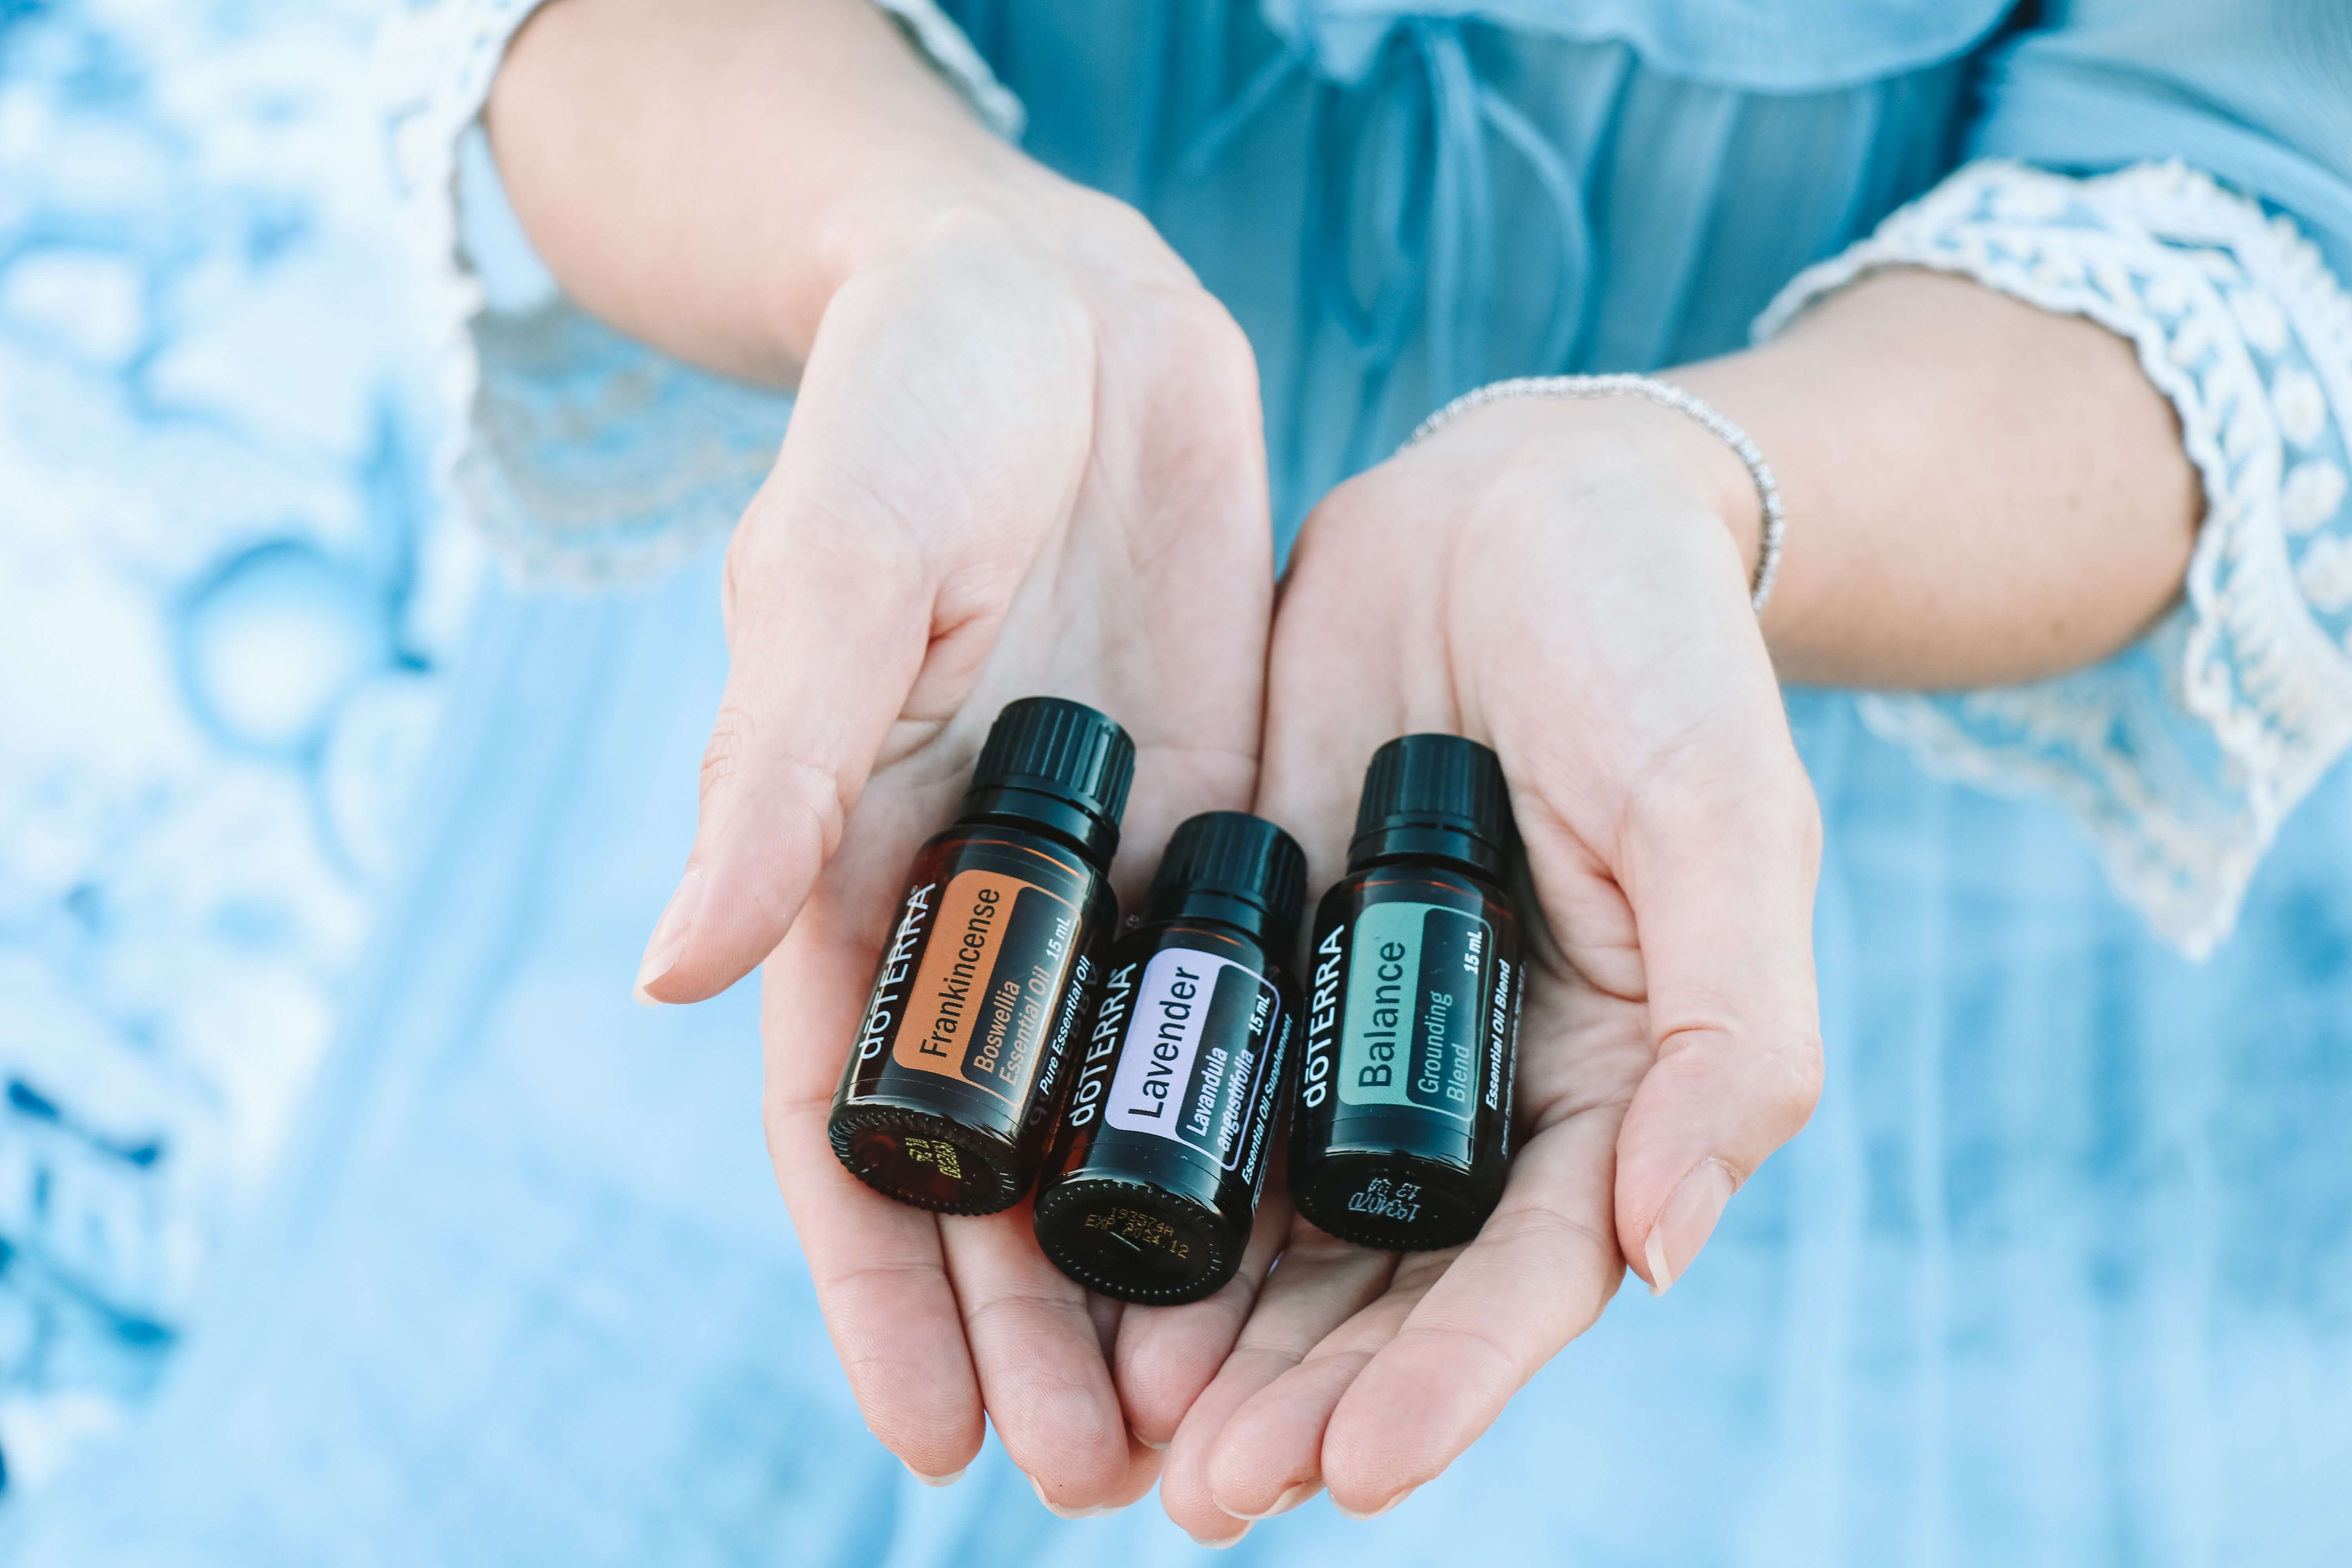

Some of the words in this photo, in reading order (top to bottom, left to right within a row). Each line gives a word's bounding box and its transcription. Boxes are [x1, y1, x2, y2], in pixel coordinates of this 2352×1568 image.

[920, 888, 1000, 1058] Frankincense
[1046, 938, 1062, 961] 15
[1056, 917, 1071, 940] mL
[1463, 953, 1479, 975] 15
[1467, 931, 1483, 954] mL
[974, 981, 1020, 1074] Boswellia
[999, 995, 1042, 1086] Essential
[1028, 965, 1051, 996] Oil
[1040, 1056, 1058, 1096] Pure
[1052, 980, 1082, 1056] Essential
[1076, 955, 1091, 981] Oil
[1248, 1013, 1264, 1036] 15
[1256, 994, 1270, 1017] mL
[1359, 942, 1405, 1087] Balance
[1492, 1008, 1505, 1034] Oil
[1495, 958, 1511, 1010] Blend
[1128, 967, 1199, 1119] Lavender
[1417, 991, 1452, 1093] Grounding
[1446, 1043, 1470, 1103] Blend
[1486, 1034, 1503, 1110] Essential
[1186, 1047, 1229, 1136] Lavandula
[1217, 1049, 1254, 1152] angustifolia
[1241, 1117, 1265, 1185] Essential
[1259, 1096, 1271, 1120] Oil
[1265, 1013, 1293, 1098] Supplement
[1085, 1214, 1116, 1230] EXP
